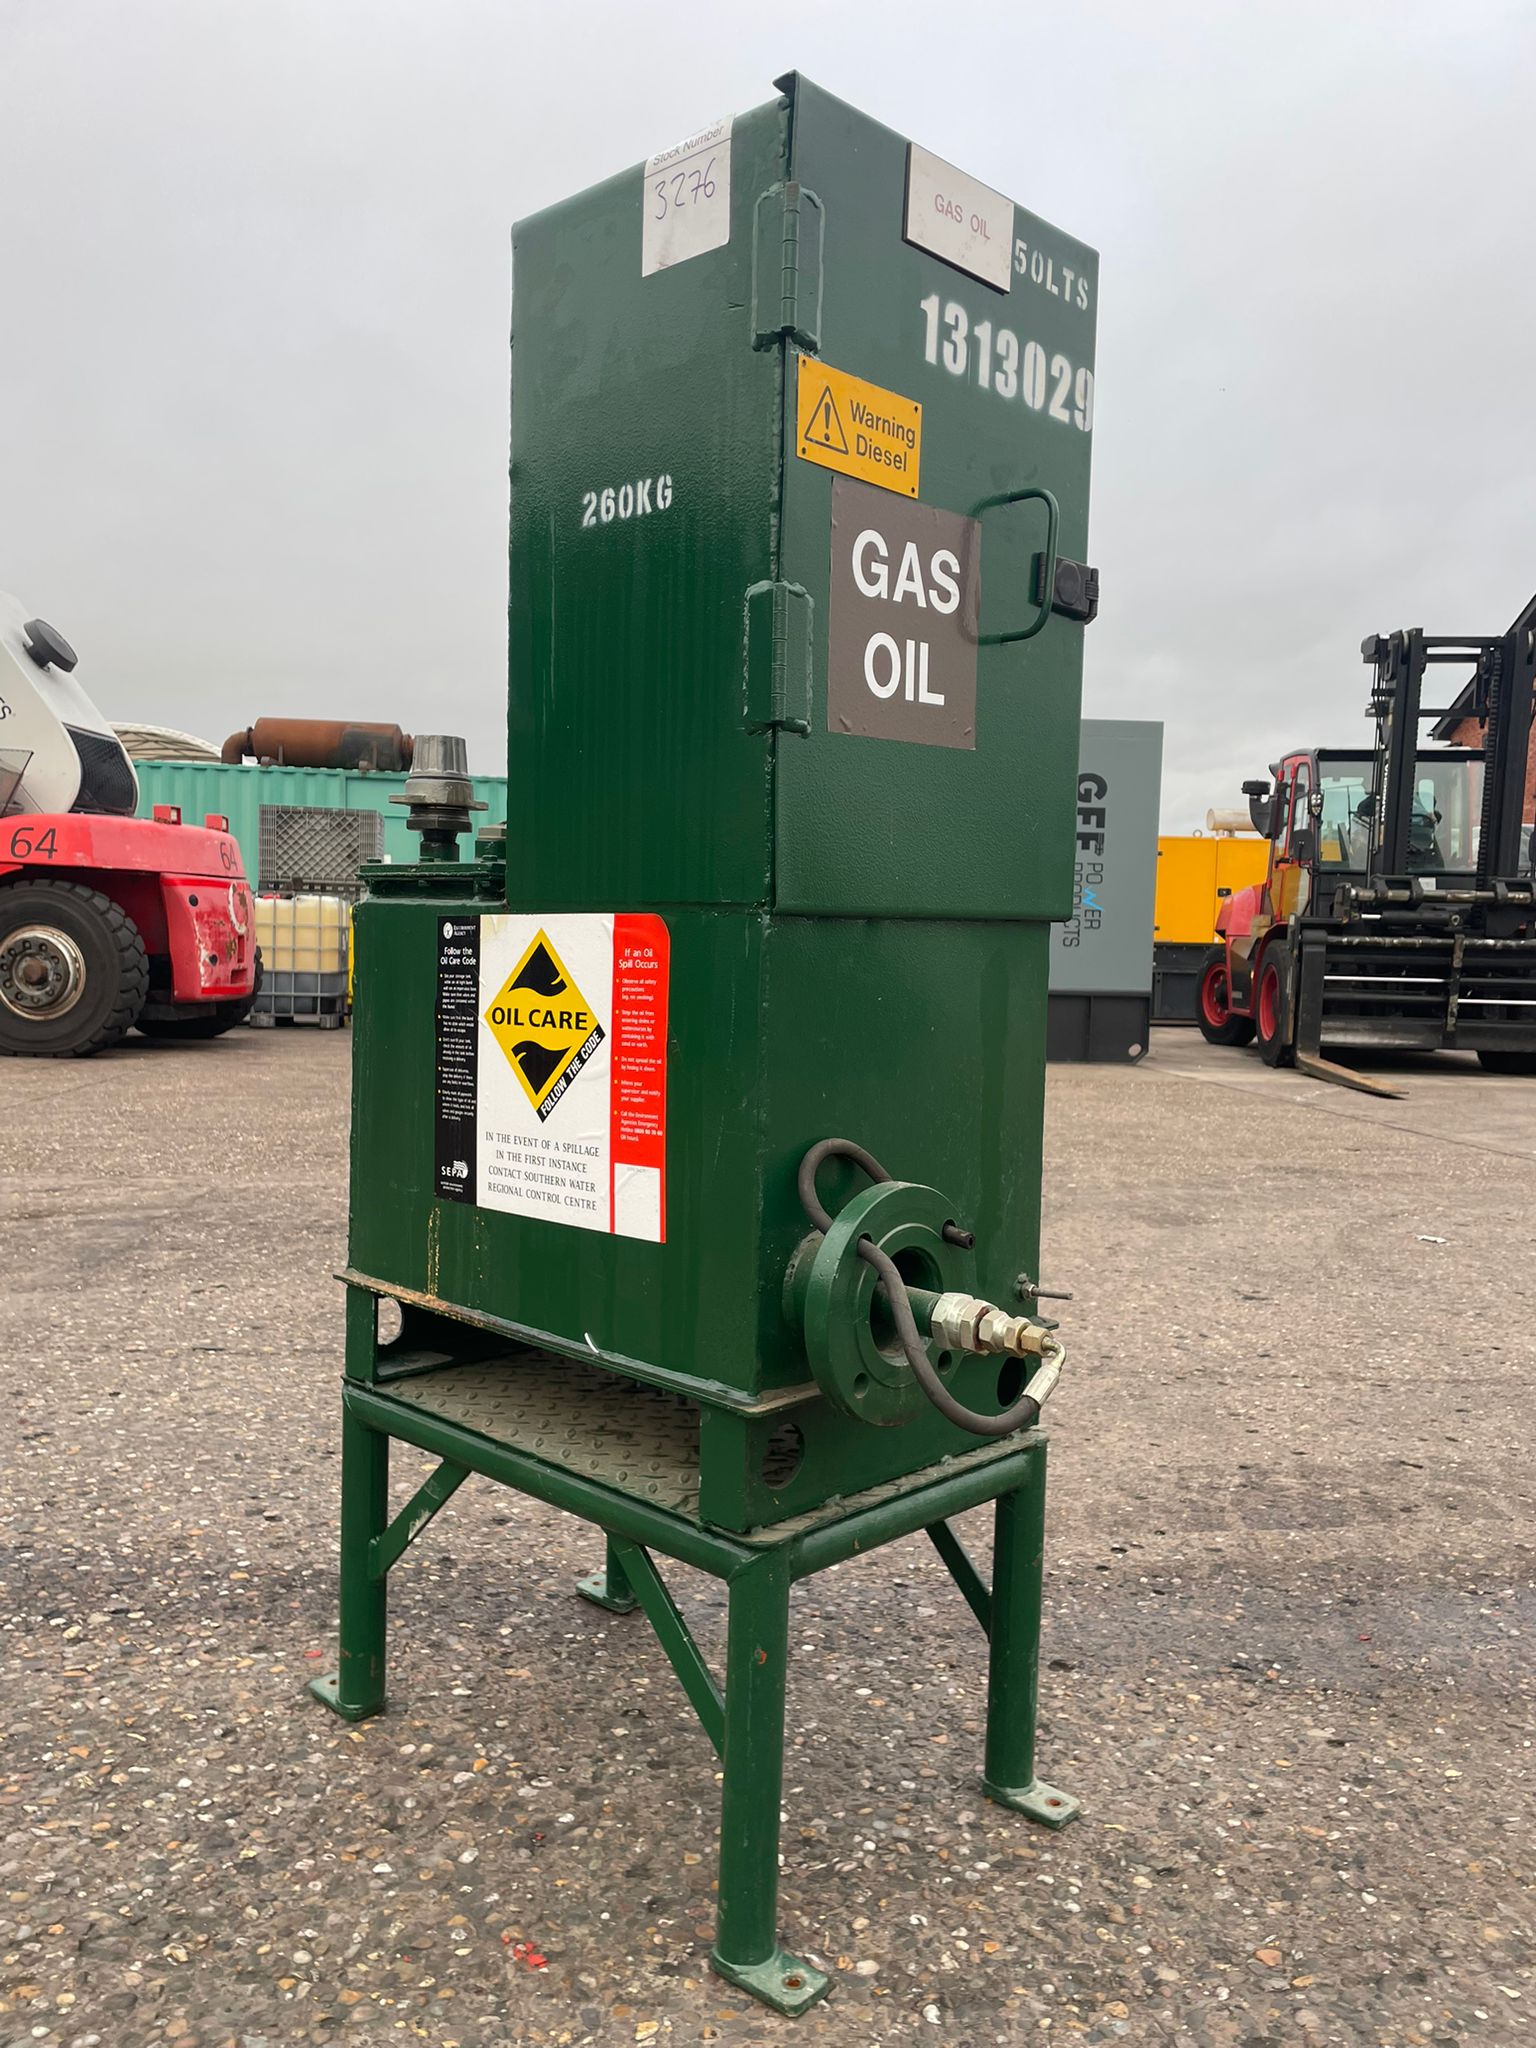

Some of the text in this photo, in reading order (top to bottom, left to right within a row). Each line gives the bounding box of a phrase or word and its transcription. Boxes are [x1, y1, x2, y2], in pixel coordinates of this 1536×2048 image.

[653, 126, 724, 166] Stock Number
[655, 157, 716, 220] 3276
[935, 194, 991, 240] GAS OIL
[1014, 238, 1088, 311] 50LTS
[920, 294, 1094, 432] 1313029
[850, 398, 916, 450] Warning
[856, 434, 907, 473] Diesel
[582, 474, 673, 528] 260KG
[852, 529, 960, 615] GAS
[864, 632, 945, 706] OIL
[10, 827, 58, 859] 64
[219, 842, 238, 871] 64
[1083, 862, 1105, 930] POWER
[440, 956, 477, 965] Oil Care Code
[444, 947, 473, 955] Follow the
[619, 959, 658, 970] Spill Occurs
[624, 948, 653, 957] If an Oil
[492, 1007, 524, 1026] OIL
[528, 1009, 588, 1030] CARE
[540, 1030, 601, 1117] FOLLOW THE CODE
[486, 1131, 600, 1157] IN THE EVENT OF A SPILLAGE
[496, 1150, 587, 1173] IN THE FIRST INSTANCE
[441, 1165, 463, 1178] SEPA
[488, 1165, 596, 1193] CONTACT SOUTHERN WATER
[488, 1181, 597, 1211] REGIONAL CONTROL CENTRE
